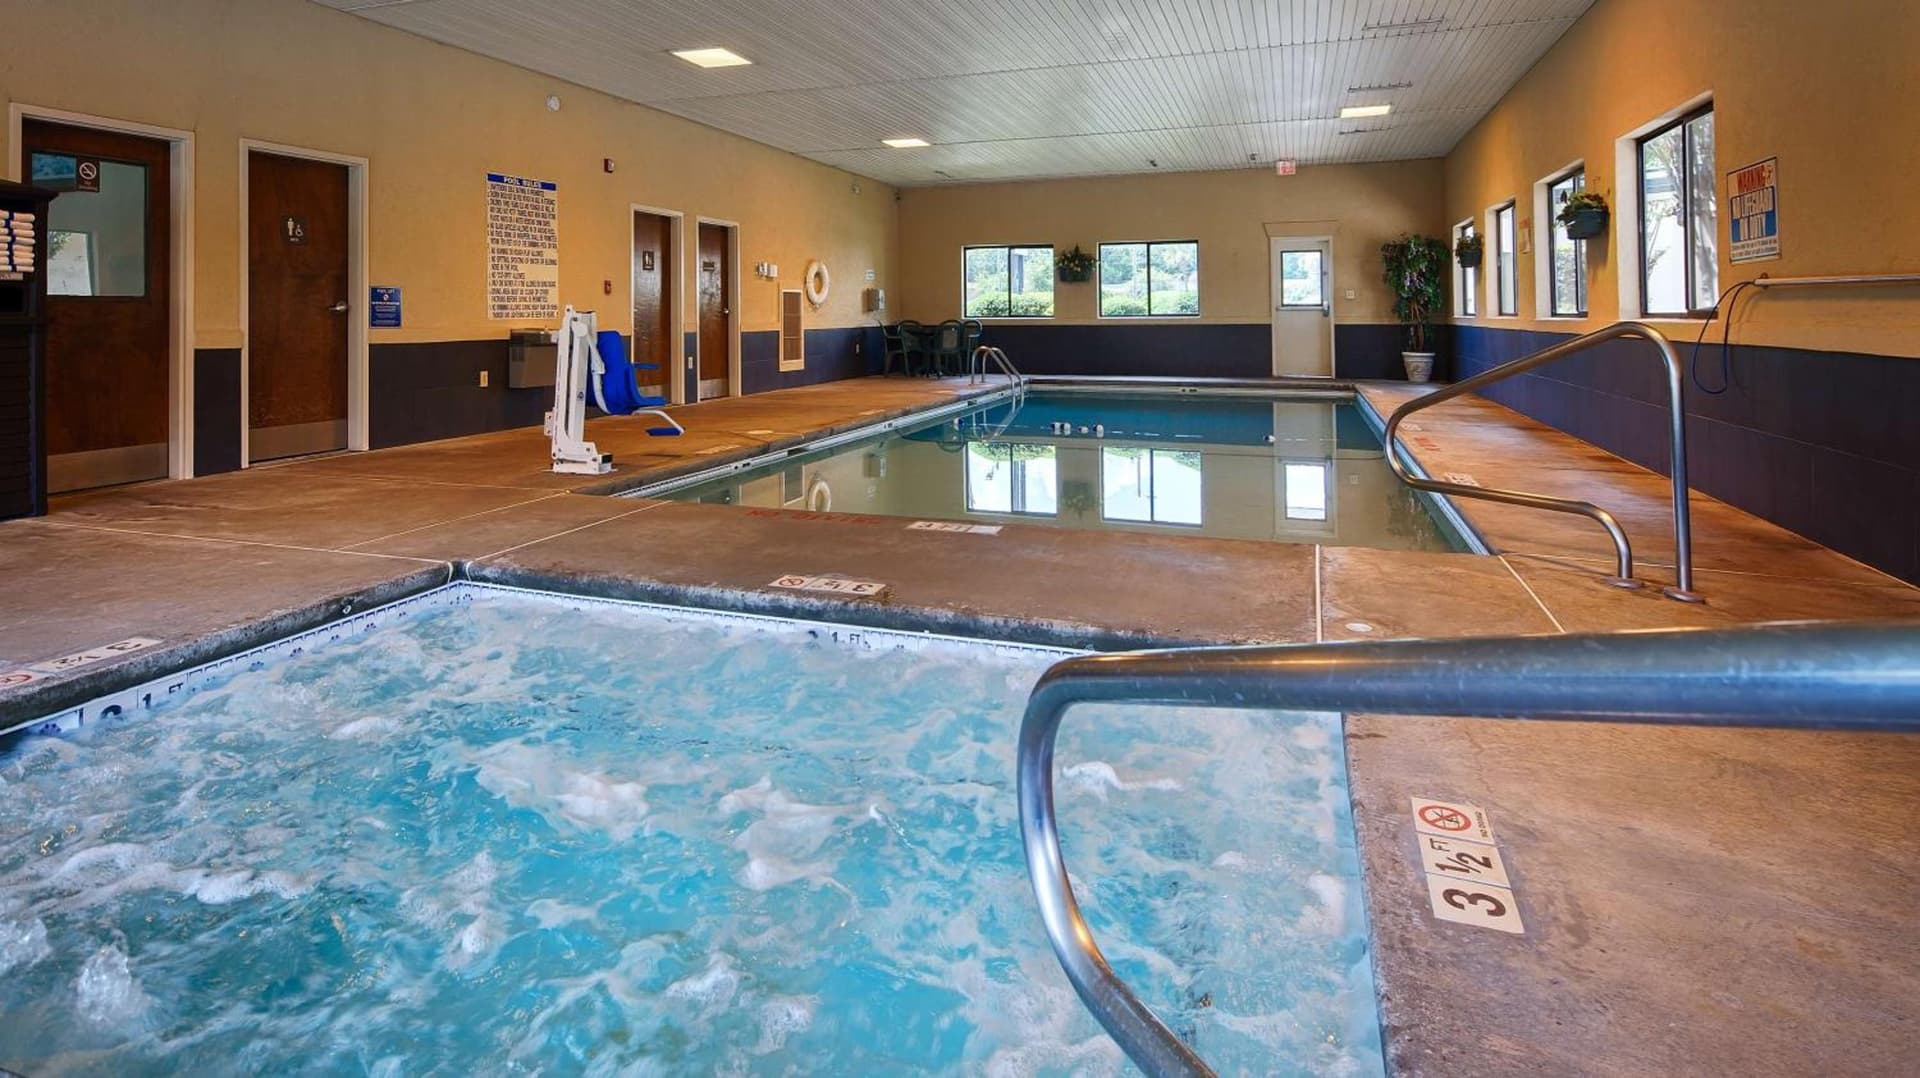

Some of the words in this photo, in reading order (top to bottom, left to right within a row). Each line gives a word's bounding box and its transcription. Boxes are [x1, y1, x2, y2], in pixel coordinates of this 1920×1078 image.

[503, 176, 521, 186] POOL
[1429, 837, 1450, 852] FT
[1434, 852, 1494, 874] 1/2
[1442, 888, 1506, 917] 3
